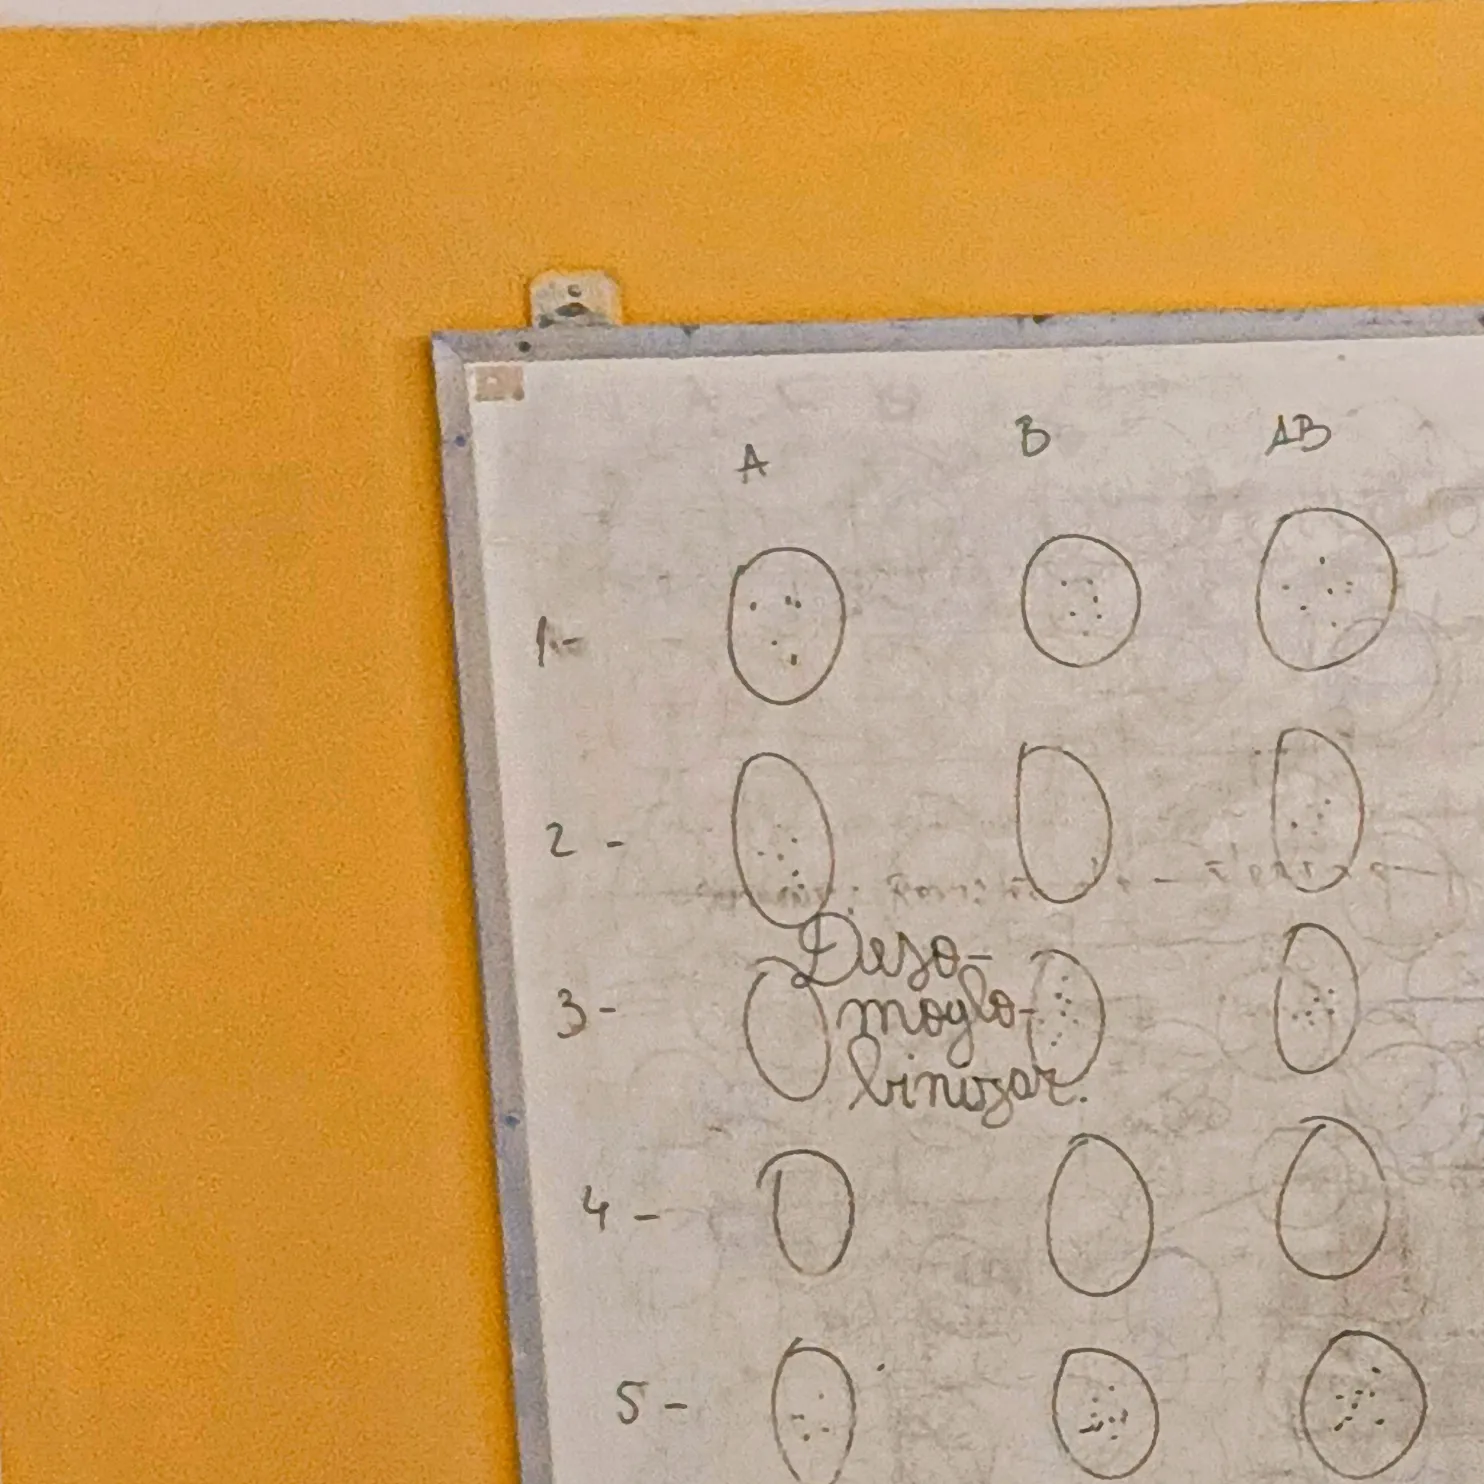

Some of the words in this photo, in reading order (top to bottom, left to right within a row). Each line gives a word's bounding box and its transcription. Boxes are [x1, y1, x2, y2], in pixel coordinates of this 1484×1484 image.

[738, 444, 769, 483] A
[1015, 416, 1051, 457] B
[1264, 414, 1333, 457] AB
